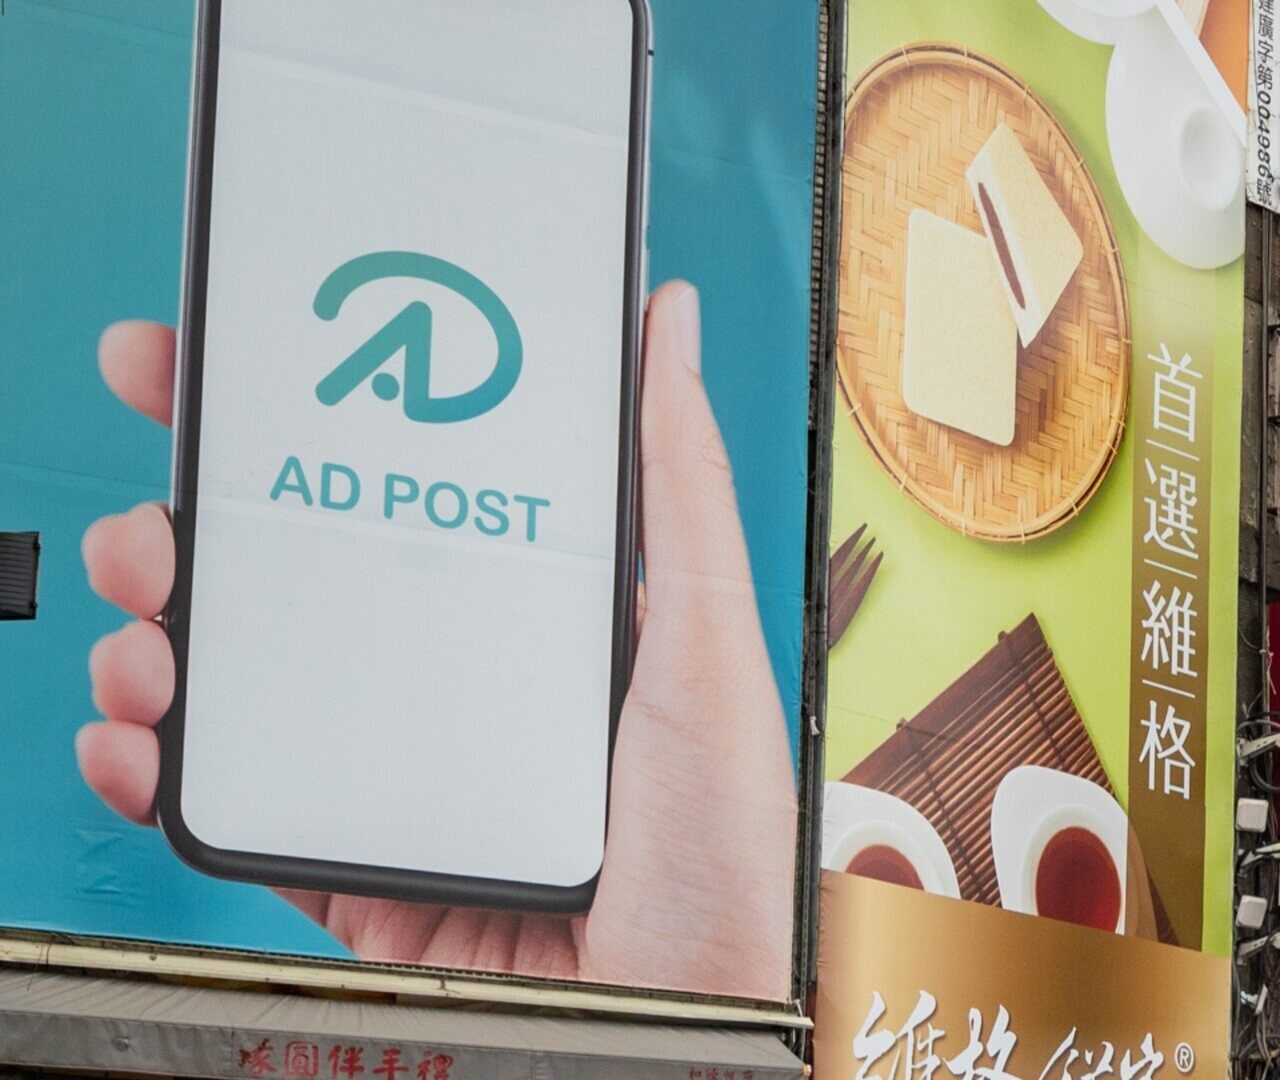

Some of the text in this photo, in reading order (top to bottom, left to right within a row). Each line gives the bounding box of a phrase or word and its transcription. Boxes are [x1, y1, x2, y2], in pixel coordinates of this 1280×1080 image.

[270, 455, 551, 543] AD POST
[1139, 342, 1203, 806] 首選維格
